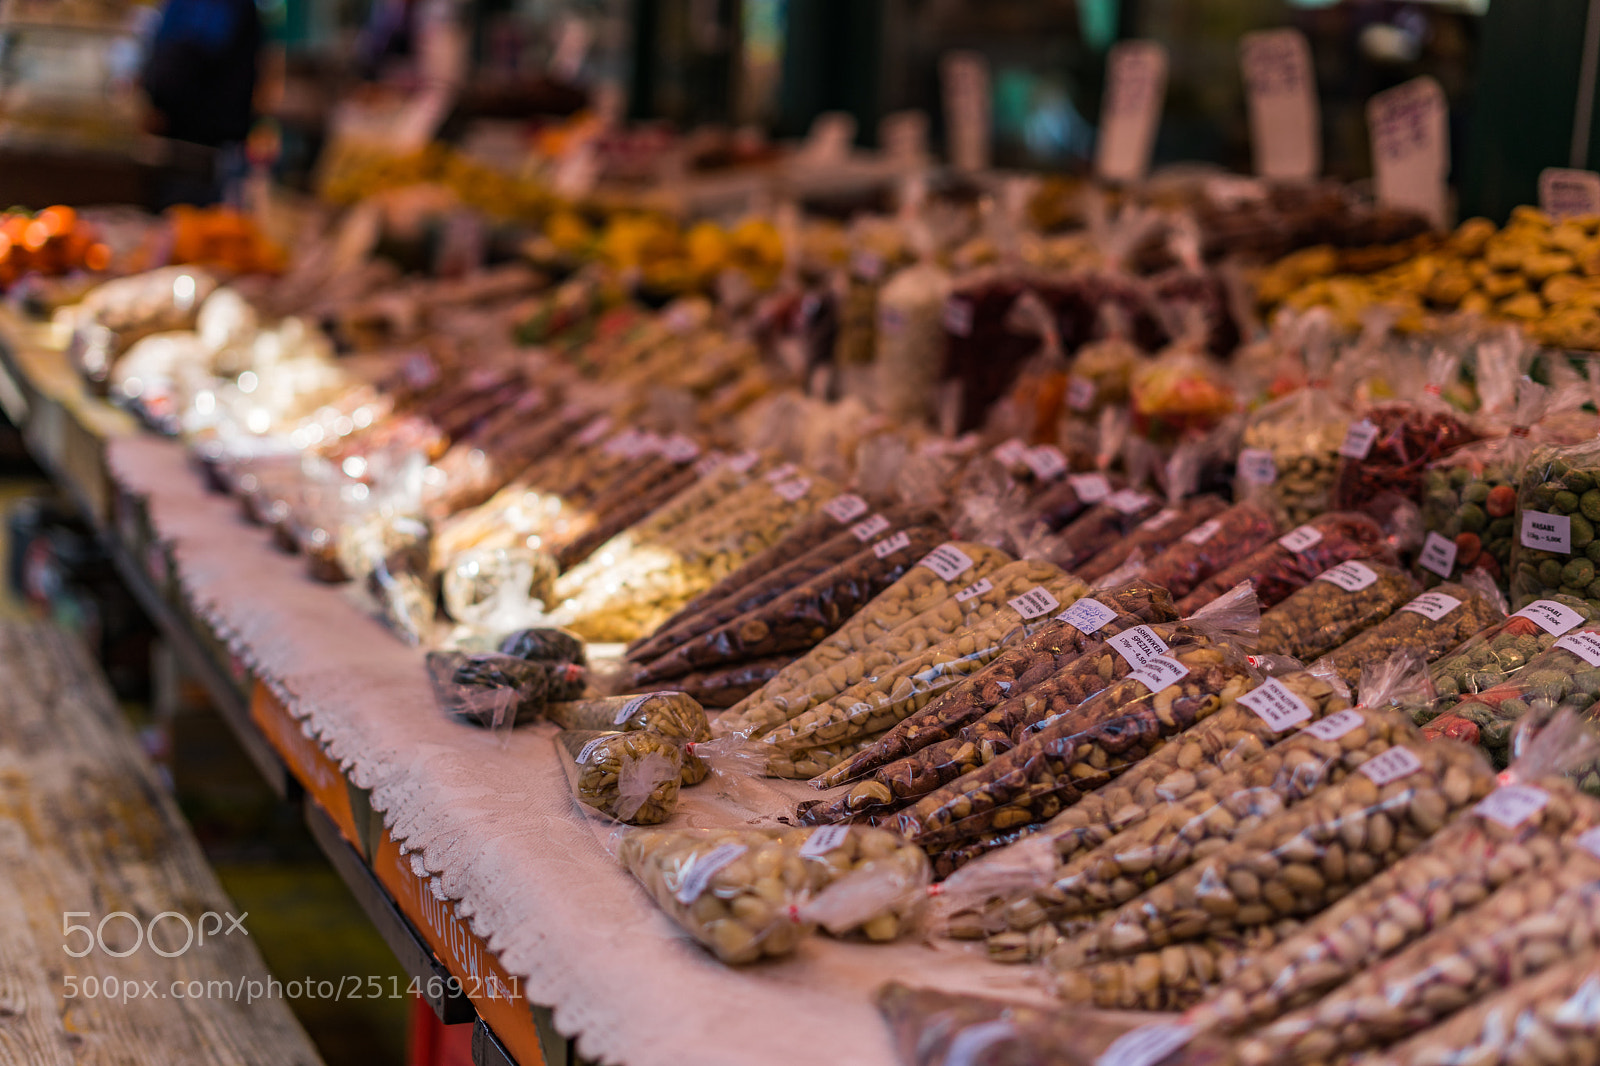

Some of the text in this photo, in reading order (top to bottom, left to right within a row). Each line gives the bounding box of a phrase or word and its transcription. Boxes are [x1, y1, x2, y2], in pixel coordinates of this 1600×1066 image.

[1531, 521, 1555, 532] WASABI
[1537, 604, 1563, 618] WASABI
[1131, 635, 1153, 657] SPEZIAL
